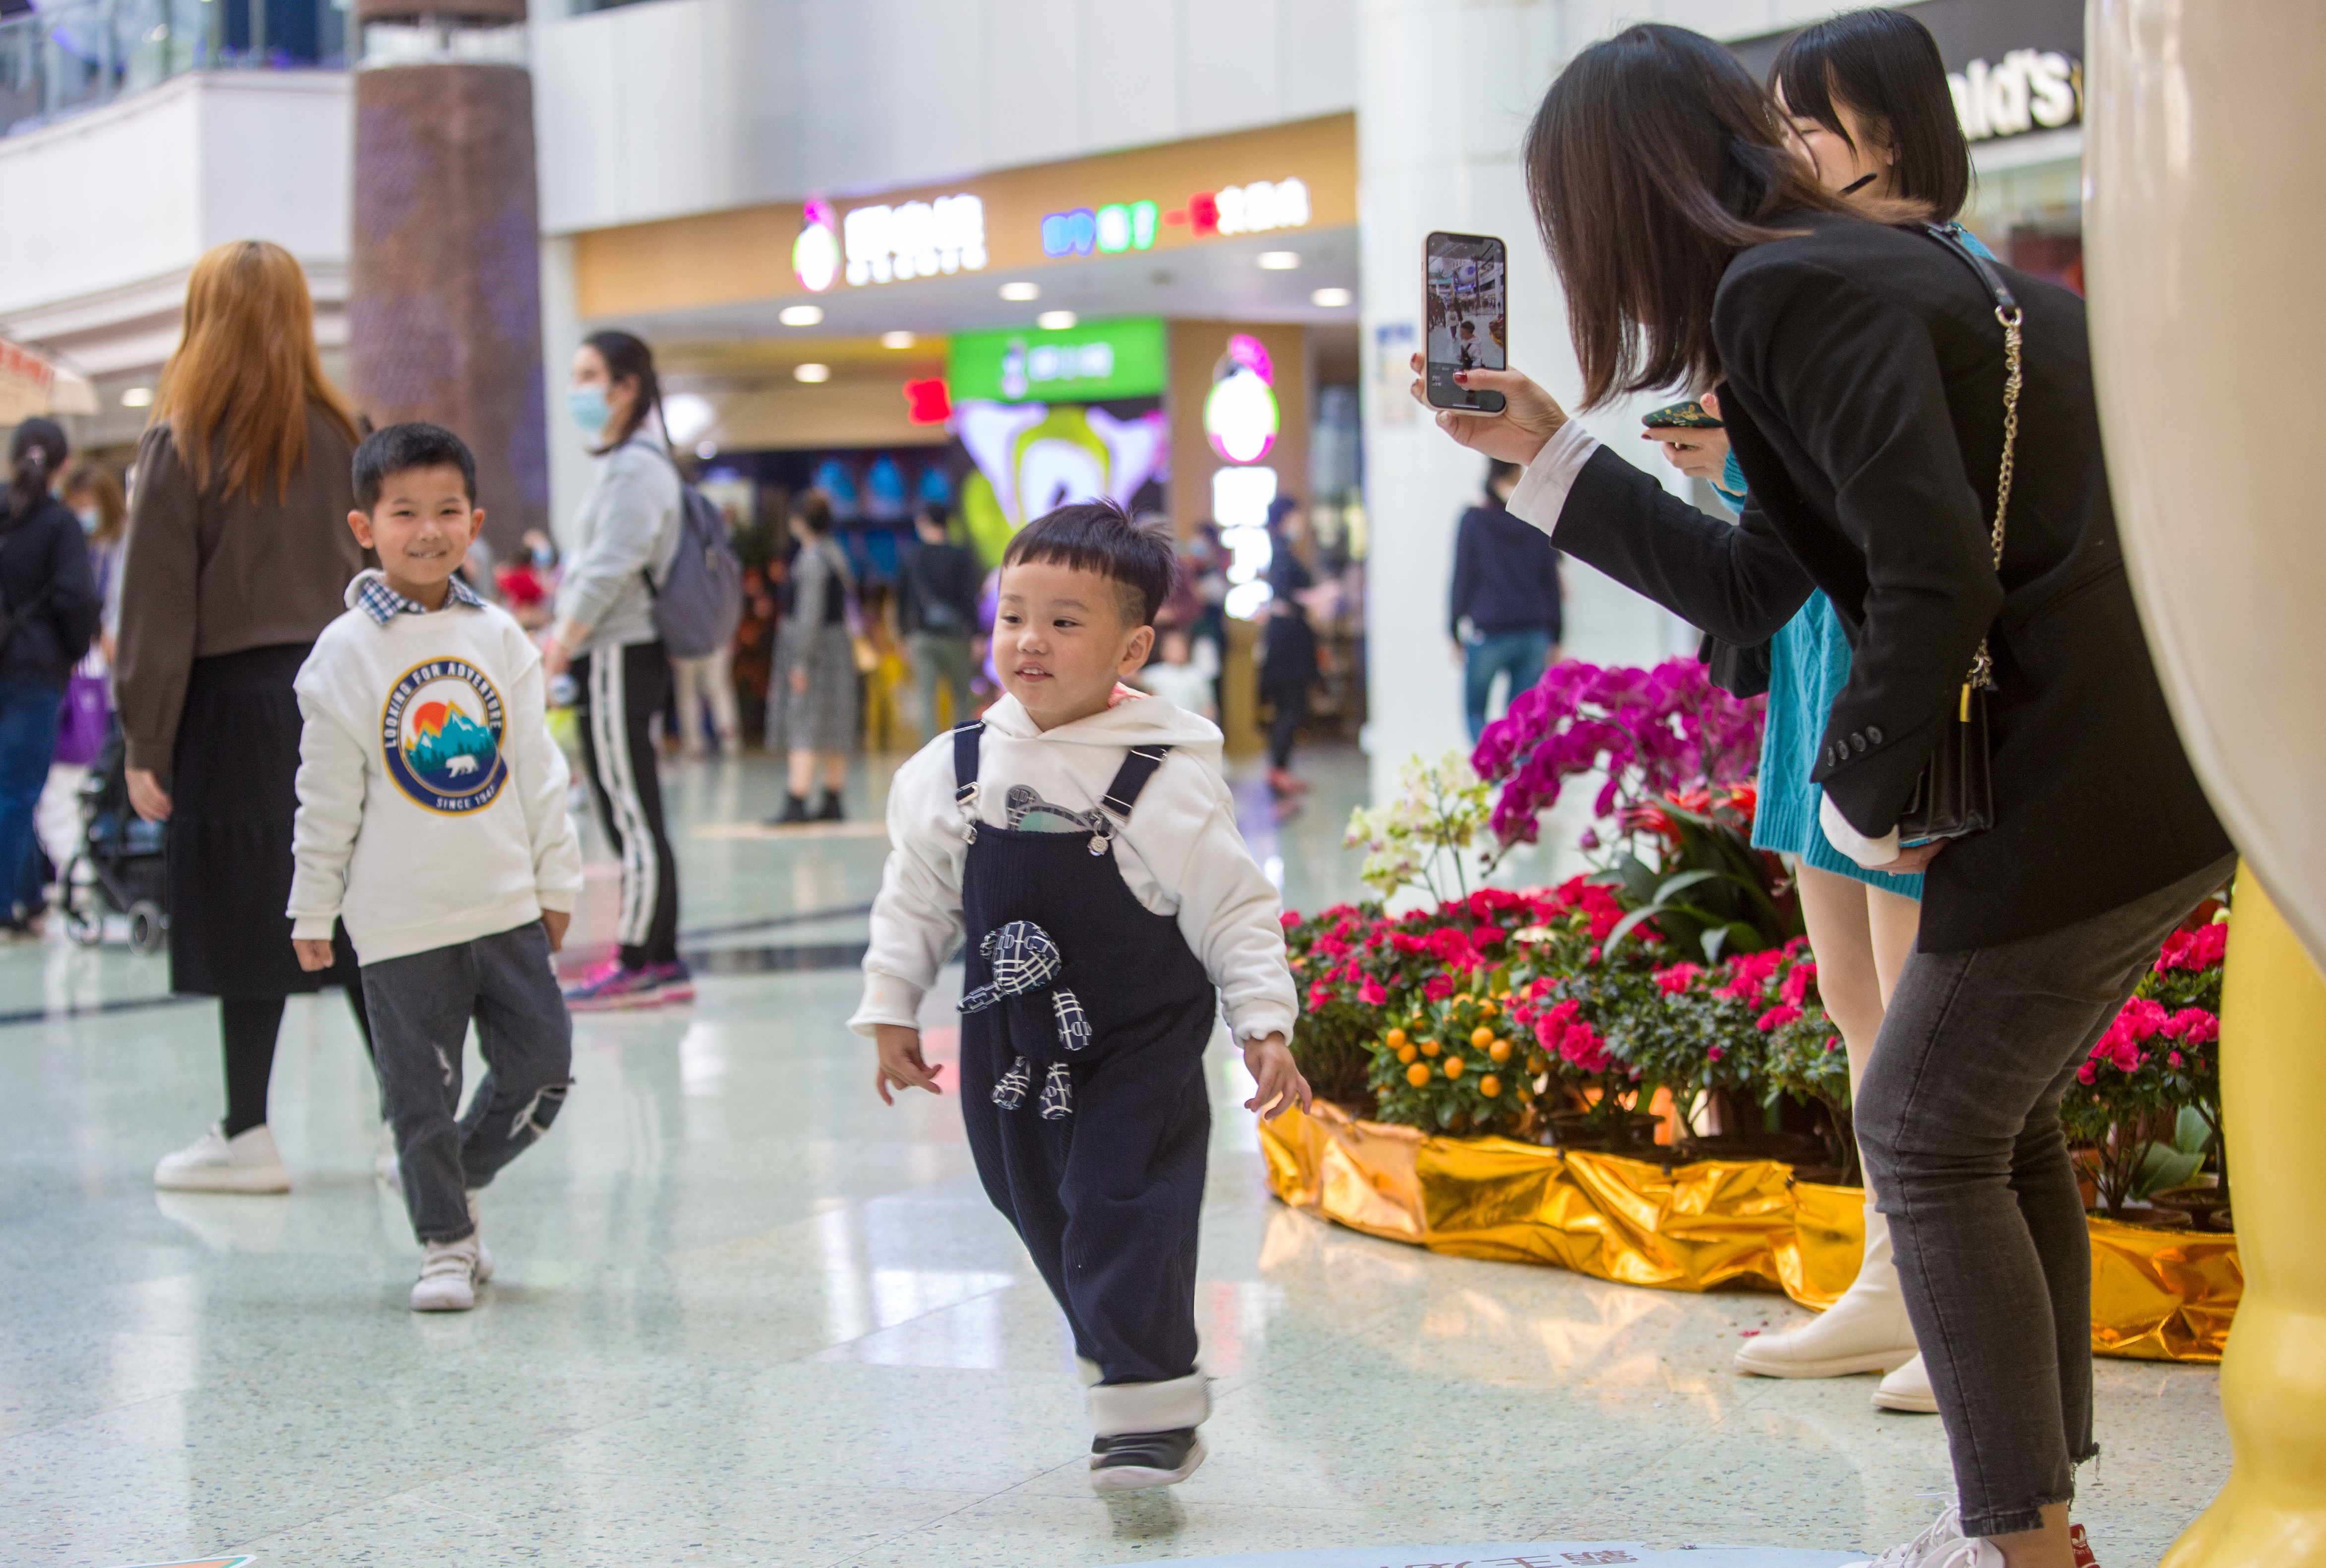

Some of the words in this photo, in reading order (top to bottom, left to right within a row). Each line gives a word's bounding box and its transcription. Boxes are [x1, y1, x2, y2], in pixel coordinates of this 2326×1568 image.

[384, 682, 411, 748] LOOKING
[412, 663, 440, 685] FOR
[447, 662, 502, 728] ADVENTURE
[436, 796, 470, 810] SINCE
[474, 784, 495, 806] 1947
